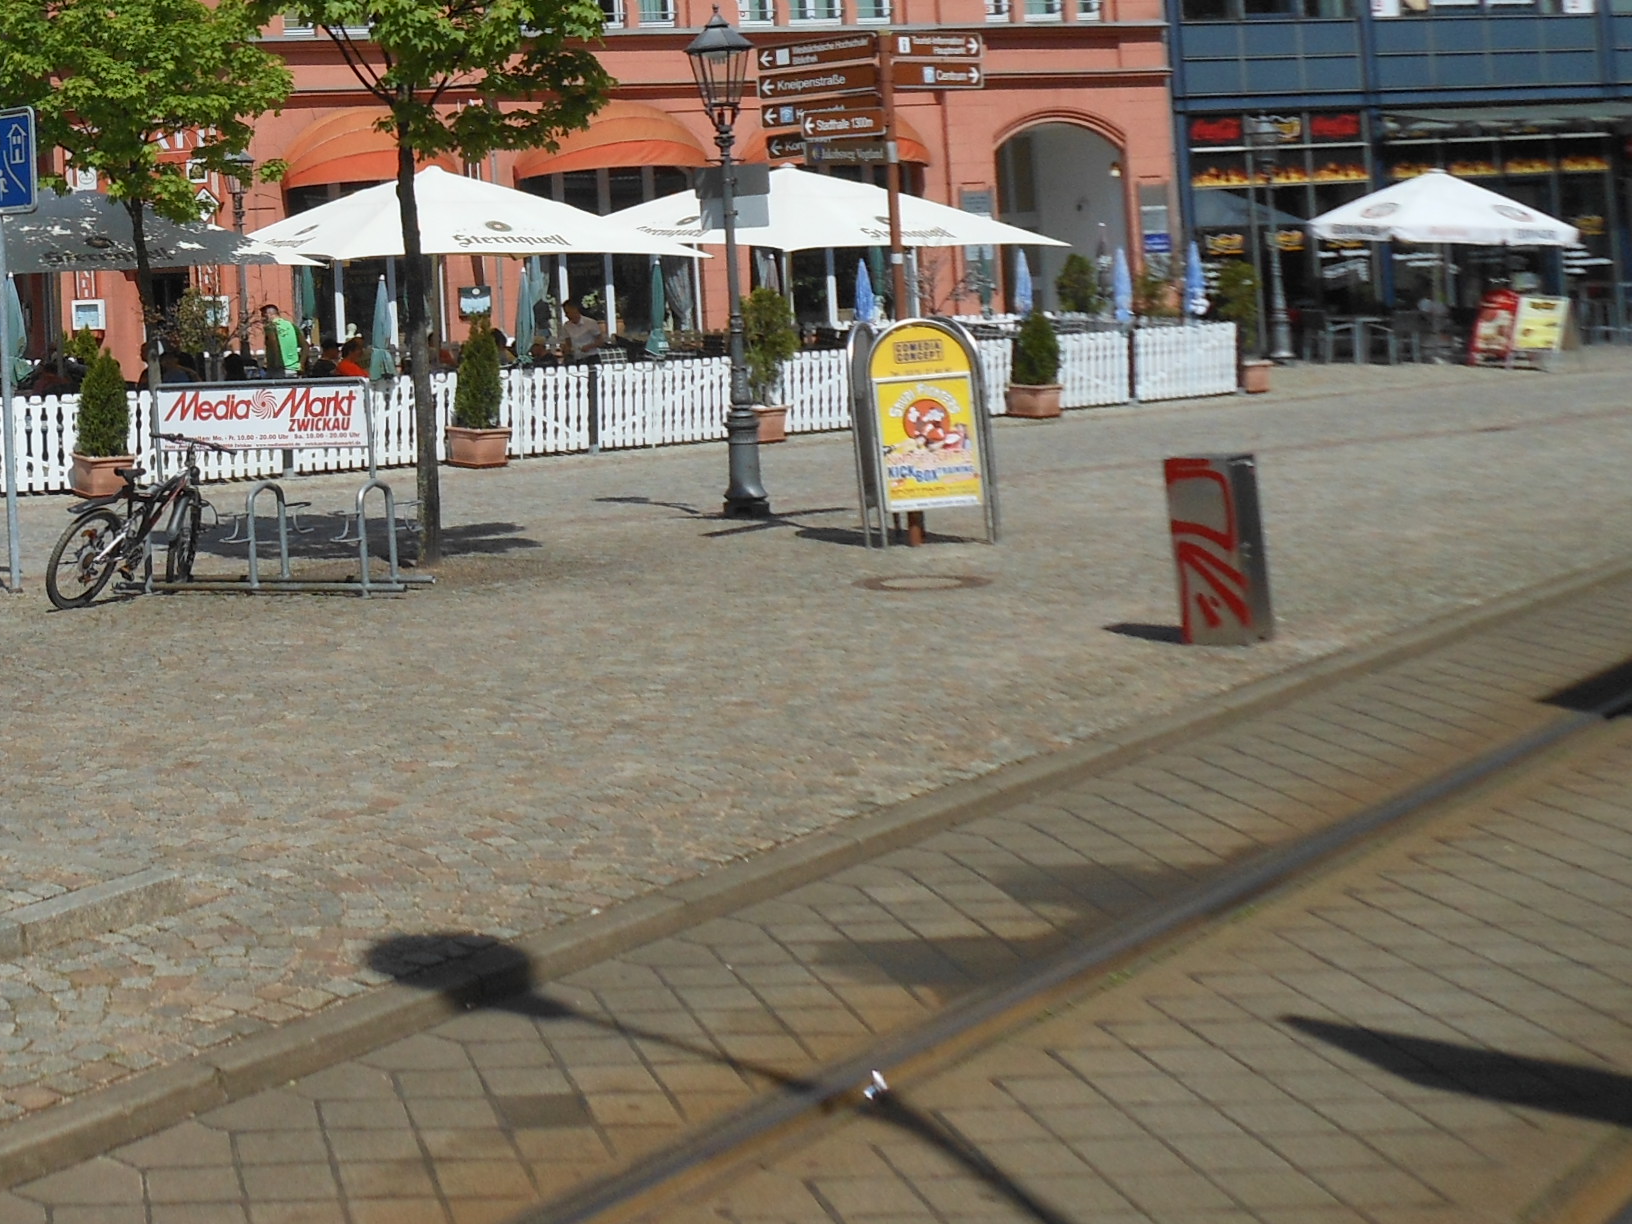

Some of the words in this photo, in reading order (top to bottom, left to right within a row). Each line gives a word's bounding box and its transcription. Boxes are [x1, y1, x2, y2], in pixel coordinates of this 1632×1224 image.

[777, 73, 847, 91] Kneipenstraße
[452, 234, 572, 248] Sternquell
[896, 342, 941, 352] COMEDIA
[896, 351, 942, 362] CONCEPT
[164, 390, 253, 422] Media
[272, 386, 357, 419] Markt
[288, 417, 351, 432] ZWICKAU
